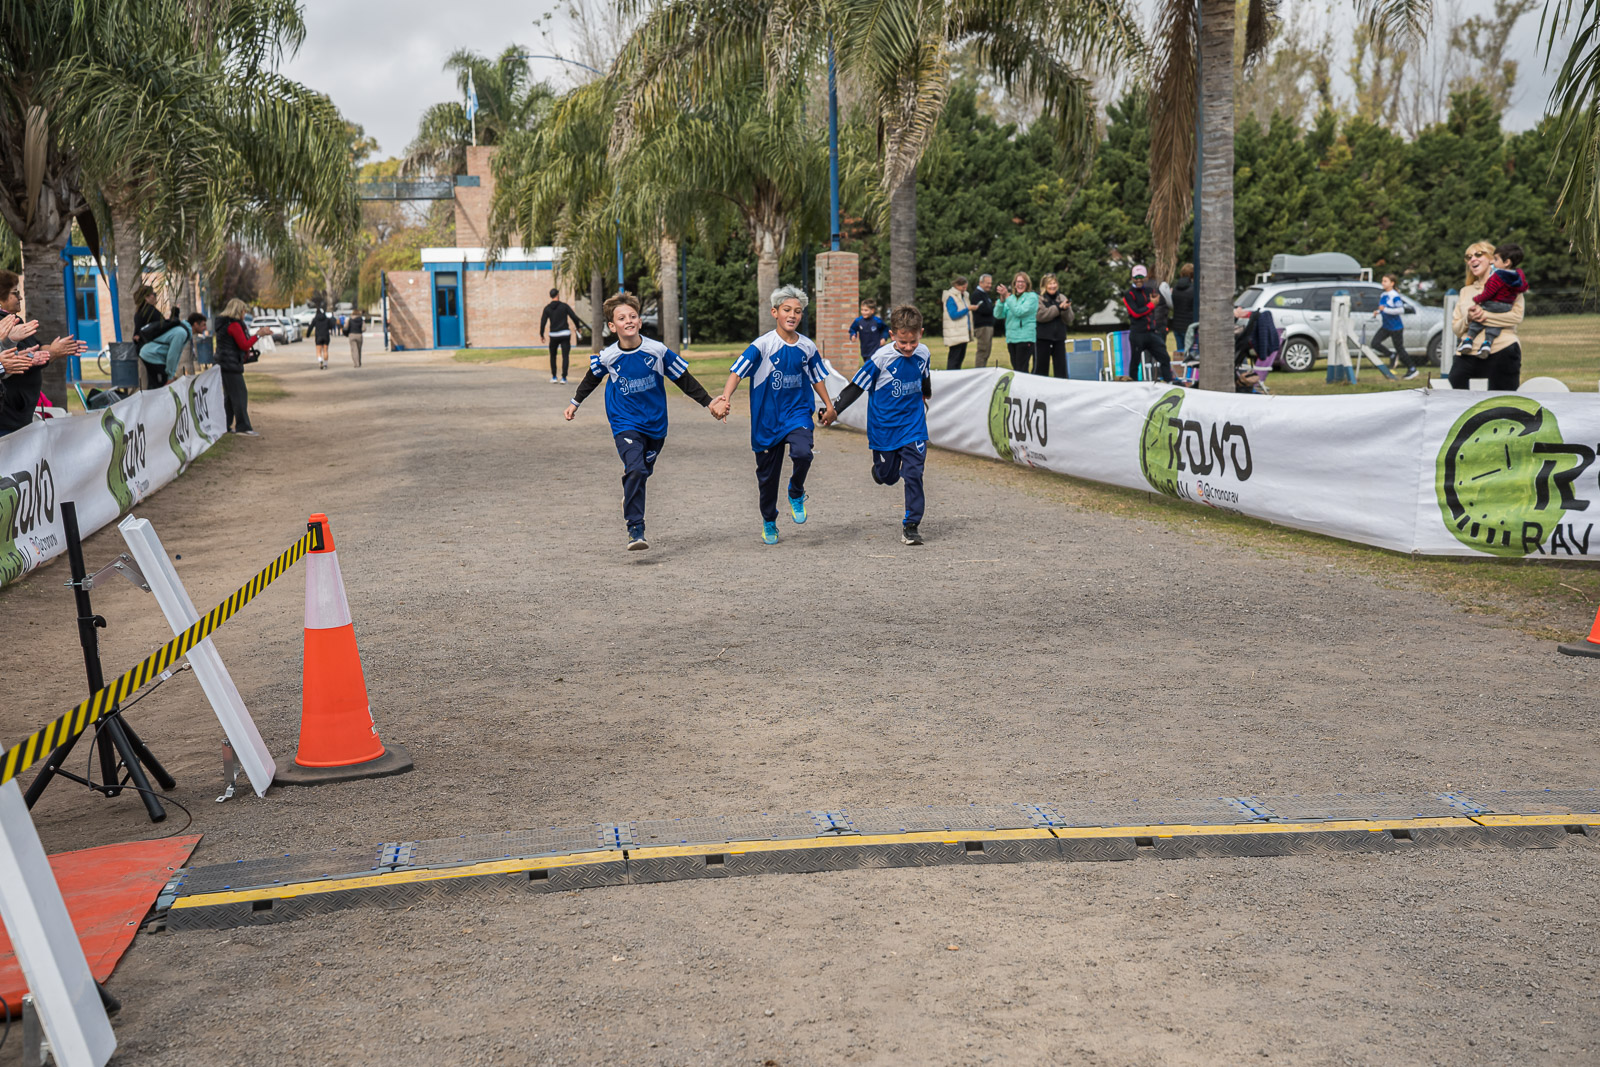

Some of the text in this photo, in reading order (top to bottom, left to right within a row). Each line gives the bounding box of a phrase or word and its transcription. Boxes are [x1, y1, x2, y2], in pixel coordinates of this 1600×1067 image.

[619, 377, 629, 395] 3
[772, 370, 783, 390] 3
[892, 379, 901, 397] 3
[1444, 407, 1600, 519] CR
[0, 458, 54, 542] RONO
[1522, 522, 1593, 555] RAV
